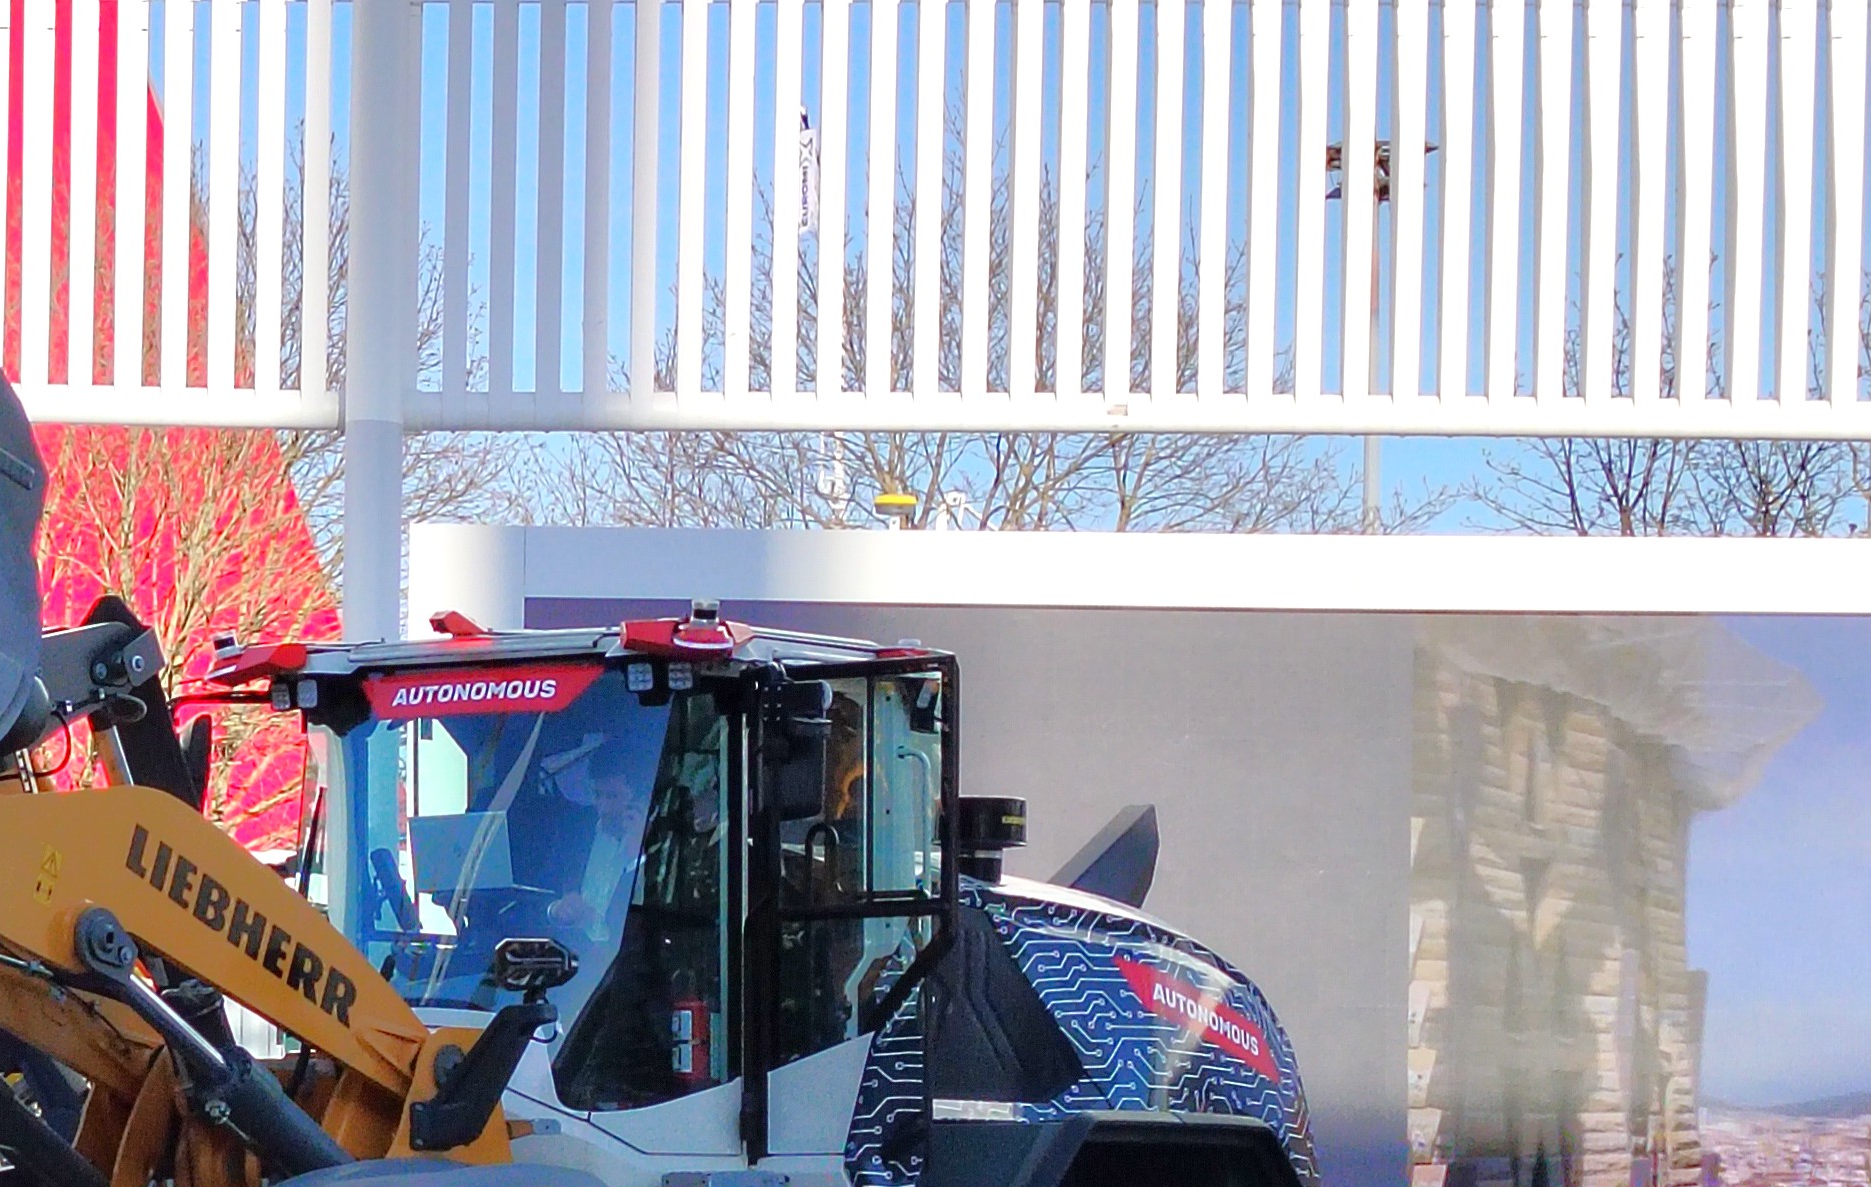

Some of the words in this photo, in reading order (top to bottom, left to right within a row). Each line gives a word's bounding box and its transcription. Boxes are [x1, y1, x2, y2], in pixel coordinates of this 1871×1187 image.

[391, 679, 557, 708] AUTONOMOUS
[125, 822, 358, 1029] LIEBHERR
[1152, 982, 1260, 1057] AUTONOMOUS
